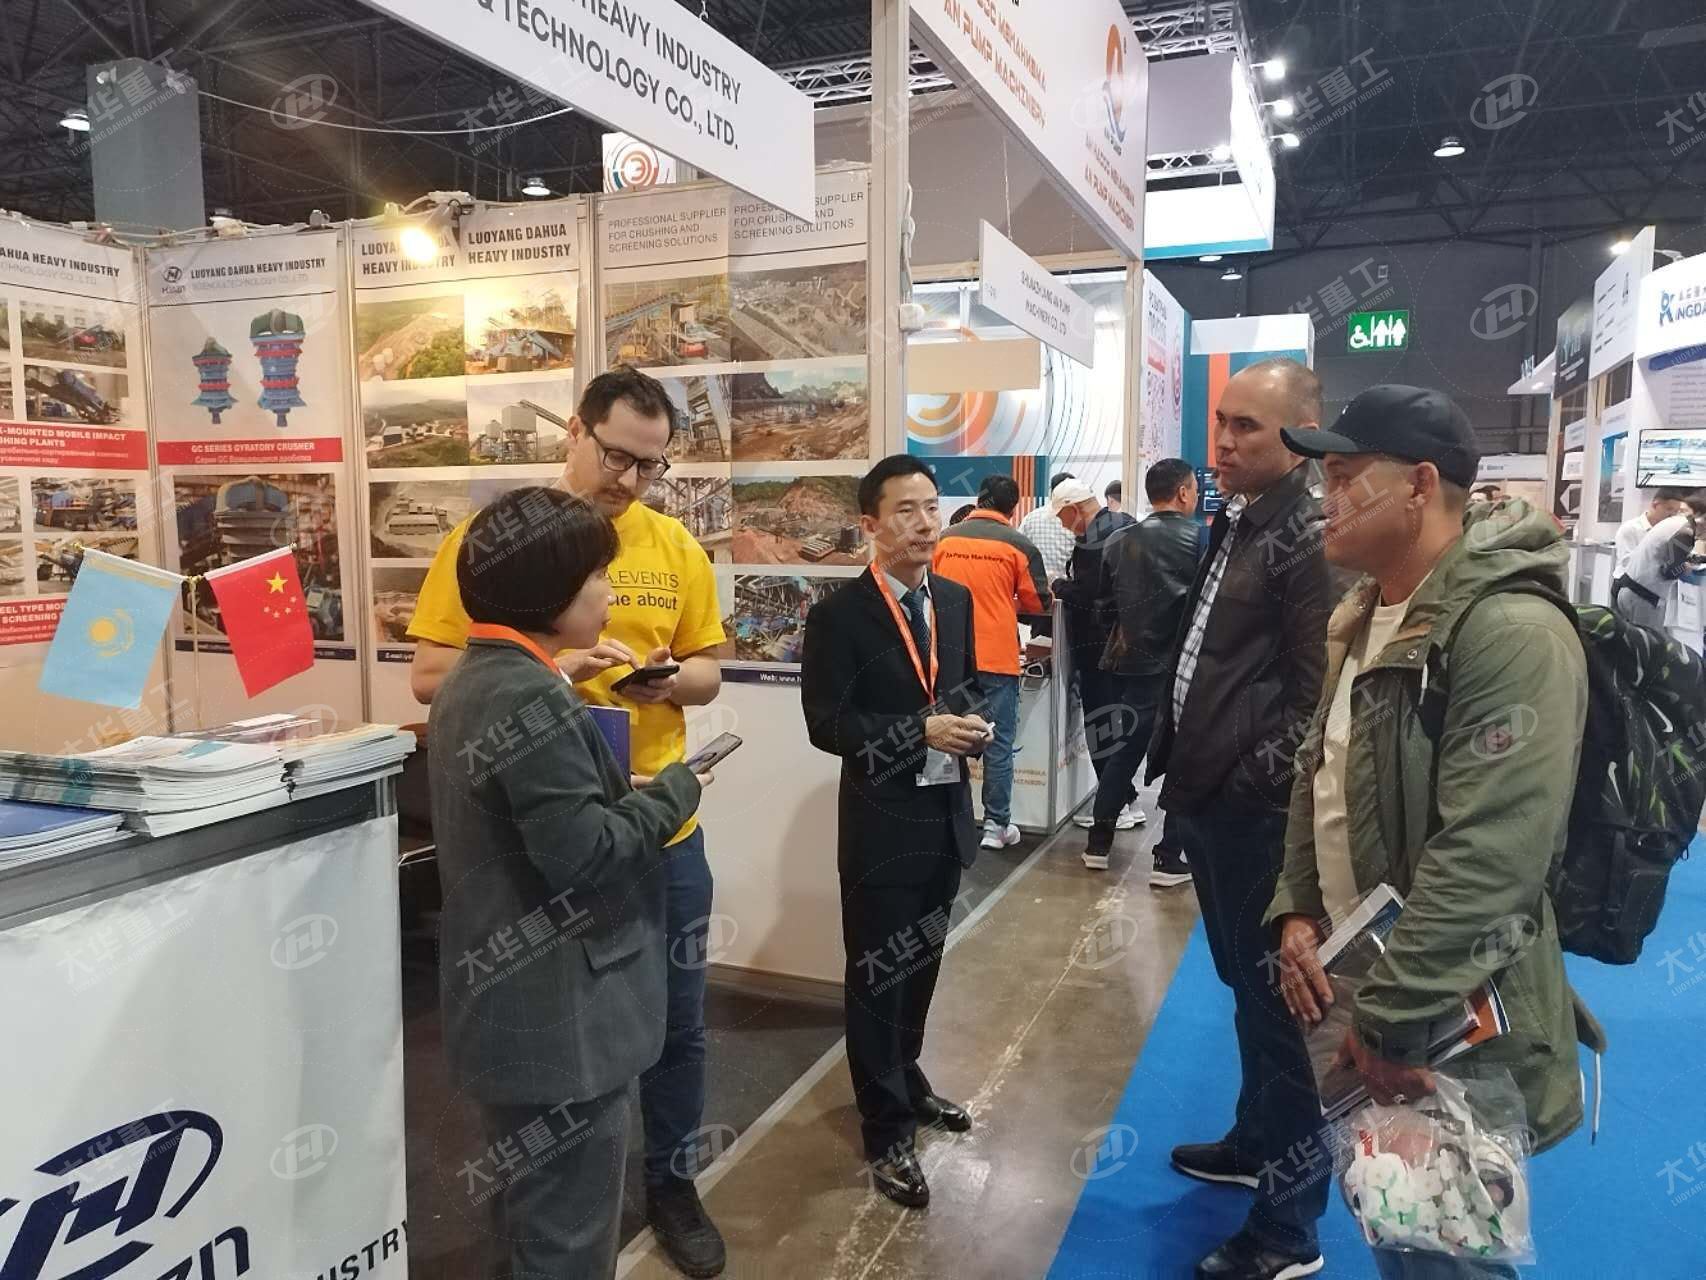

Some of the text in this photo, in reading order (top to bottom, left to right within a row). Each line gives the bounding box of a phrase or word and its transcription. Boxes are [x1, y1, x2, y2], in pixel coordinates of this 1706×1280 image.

[655, 28, 740, 104] INDUSTRY
[665, 86, 702, 135] CO.,
[707, 110, 739, 150] LTD.
[609, 207, 727, 230] PROFESSIONAL SUPPLIER
[734, 217, 755, 227] FOR
[734, 218, 855, 240] SCREENING SOLUTIONS
[468, 229, 523, 245] LUOYANG
[526, 223, 567, 239] DAHUA
[609, 223, 700, 241] FOR CRUSHING AND
[609, 232, 719, 254] SCREENING SOLUTIONS
[32, 253, 67, 268] HEAVY
[70, 259, 120, 277] INDUSTRY
[468, 244, 572, 265] HEAVY INDUSTRY
[191, 257, 326, 279] LUOYANG DAHUA HEAVY INDUSTRY
[363, 257, 399, 275] HEAVY
[30, 438, 66, 448] PLANTS
[56, 430, 91, 439] MOBILE
[92, 433, 126, 441] IMPACT
[204, 444, 232, 453] SERIES
[20, 604, 44, 613] TYPE
[637, 591, 678, 610] about
